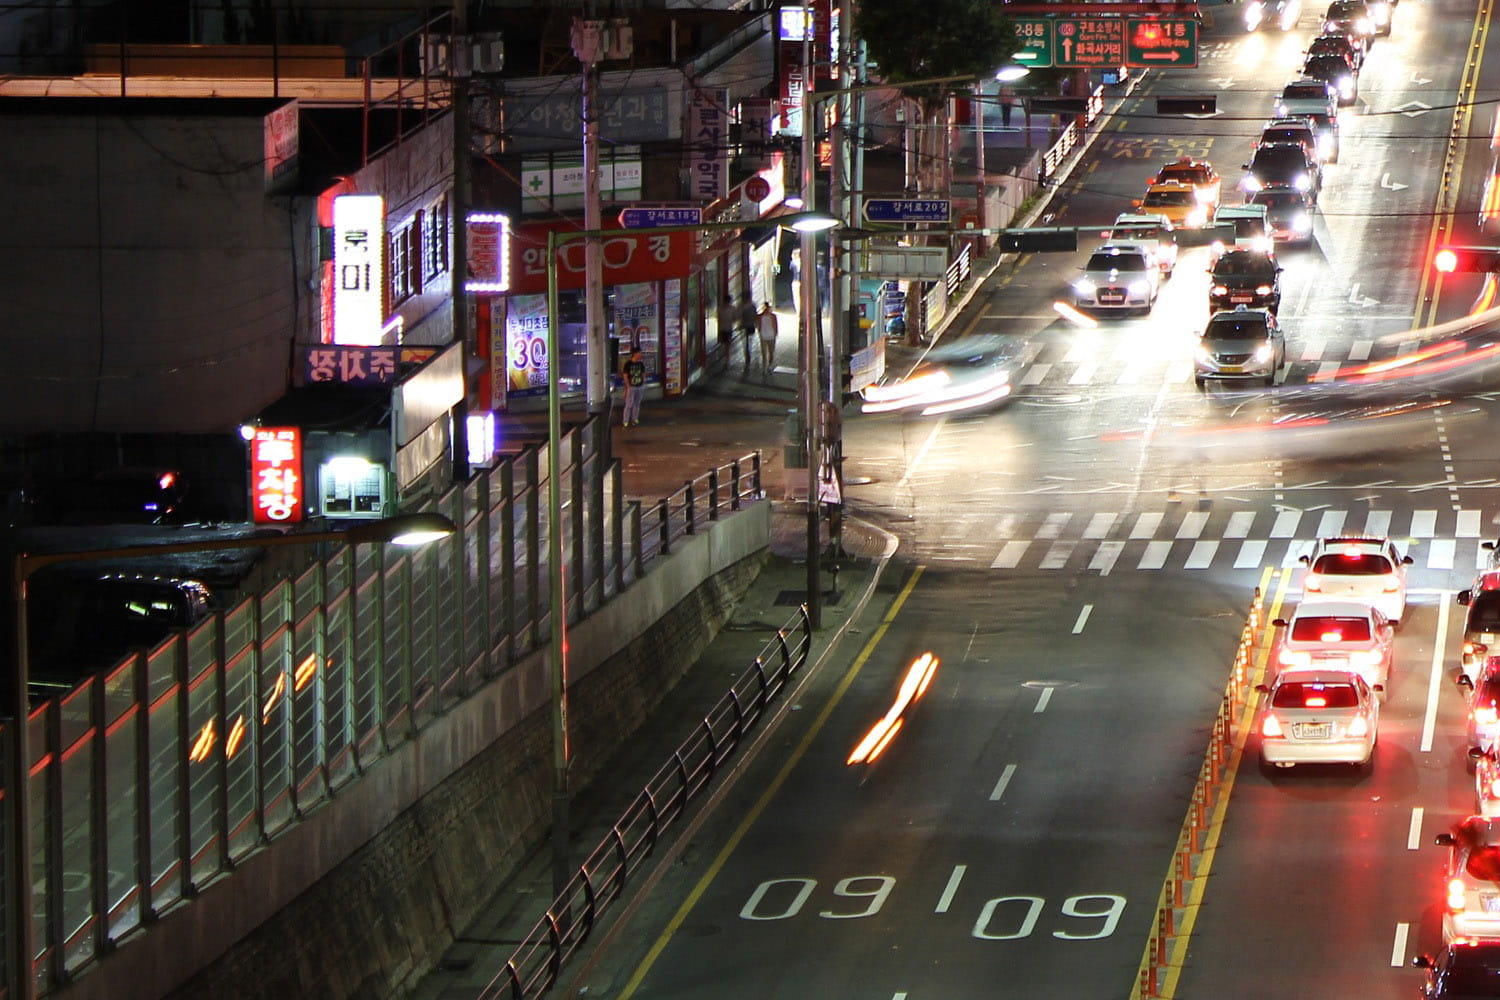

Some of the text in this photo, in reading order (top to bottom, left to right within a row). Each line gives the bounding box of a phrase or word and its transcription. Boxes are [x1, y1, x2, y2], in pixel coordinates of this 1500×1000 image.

[1078, 21, 1121, 34] 구로소방서
[1076, 42, 1121, 56] 화곡사거리
[892, 202, 948, 214] 강서로20길
[647, 209, 699, 223] 강서로18길
[257, 441, 298, 521] 주차장
